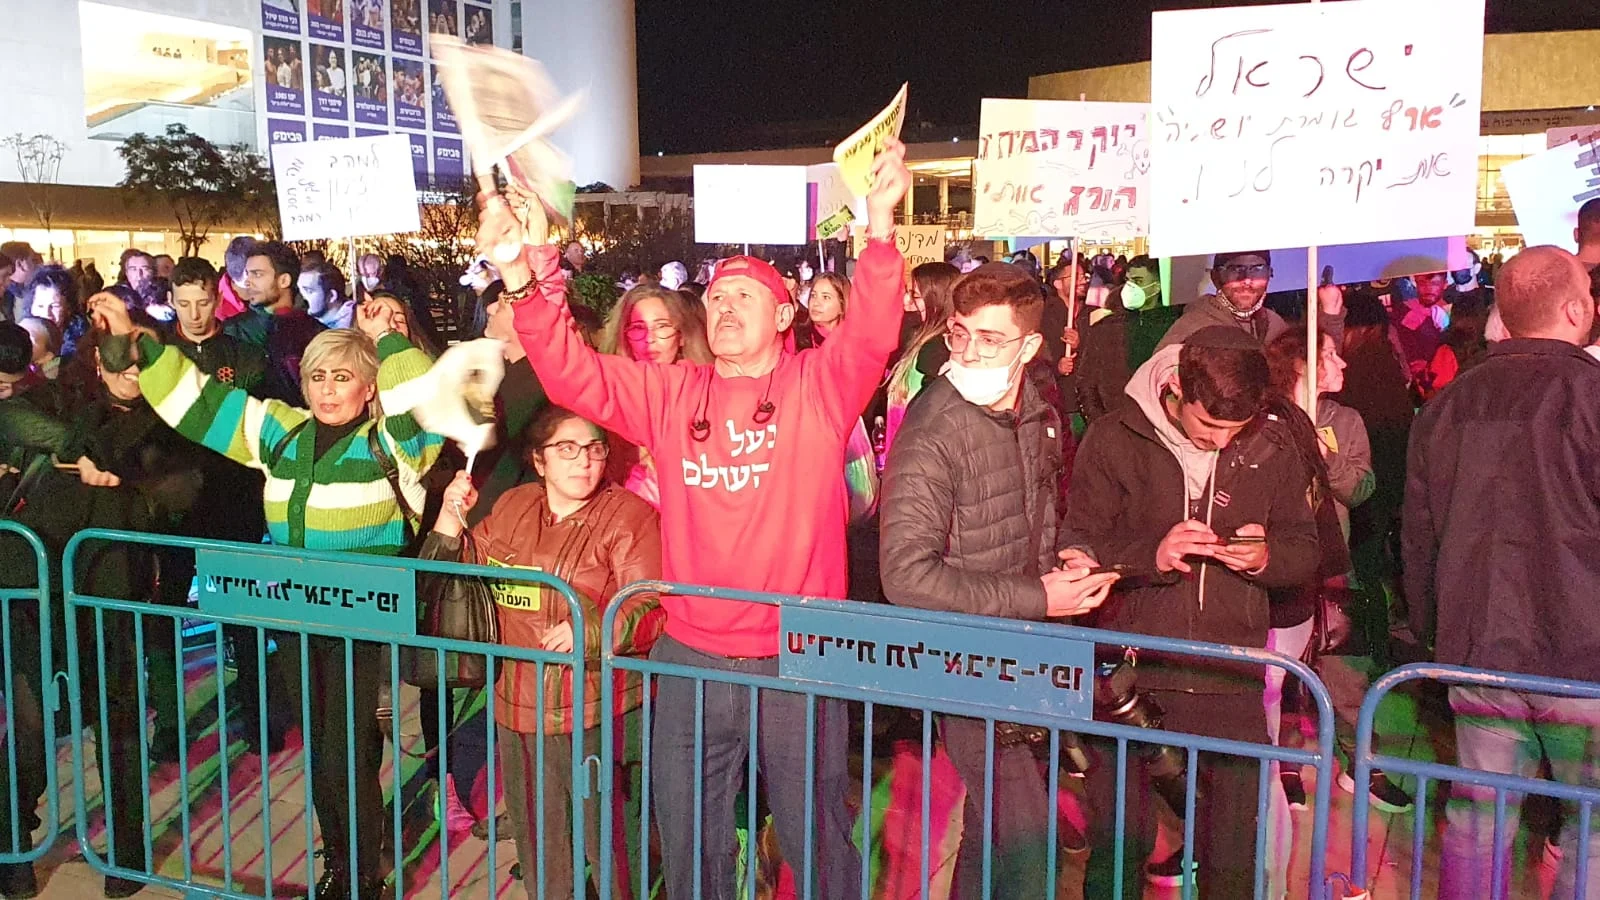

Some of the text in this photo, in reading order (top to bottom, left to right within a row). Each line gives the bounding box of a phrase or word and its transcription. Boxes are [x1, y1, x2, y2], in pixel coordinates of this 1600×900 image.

[1195, 28, 1413, 98] ישראל
[1066, 124, 1136, 170] יוקר
[1319, 158, 1382, 204] יקרה
[1386, 152, 1451, 189] את
[682, 453, 770, 492] העולם
[506, 594, 531, 607] העם
